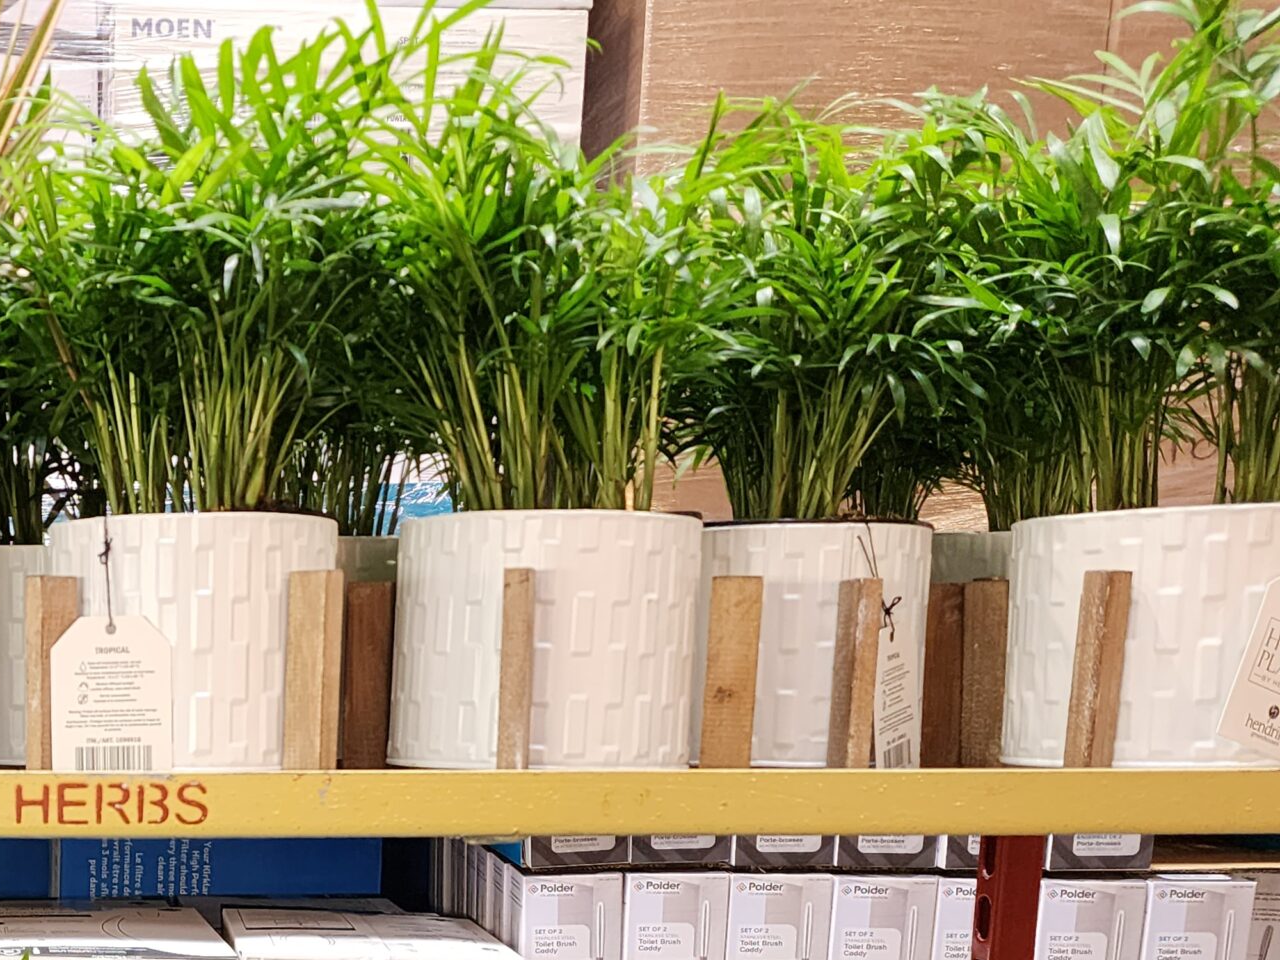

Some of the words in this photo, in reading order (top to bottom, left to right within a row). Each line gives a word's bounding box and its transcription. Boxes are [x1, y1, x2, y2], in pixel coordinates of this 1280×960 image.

[131, 18, 212, 39] MOEN
[400, 36, 419, 45] SPT
[95, 646, 130, 654] TROPICAL
[14, 781, 209, 825] HERBS
[135, 852, 144, 863] Le
[203, 841, 212, 863] Your
[88, 859, 96, 876] pur
[190, 850, 200, 871] High
[101, 857, 109, 879] mois
[158, 856, 166, 883] clean
[134, 864, 144, 888] filtre
[180, 865, 189, 895] should
[540, 884, 574, 893] Polder
[646, 882, 680, 890] Polder
[748, 883, 783, 891] Polder
[854, 886, 889, 894] Polder
[1060, 890, 1096, 899] Polder
[1170, 890, 1206, 899] Polder
